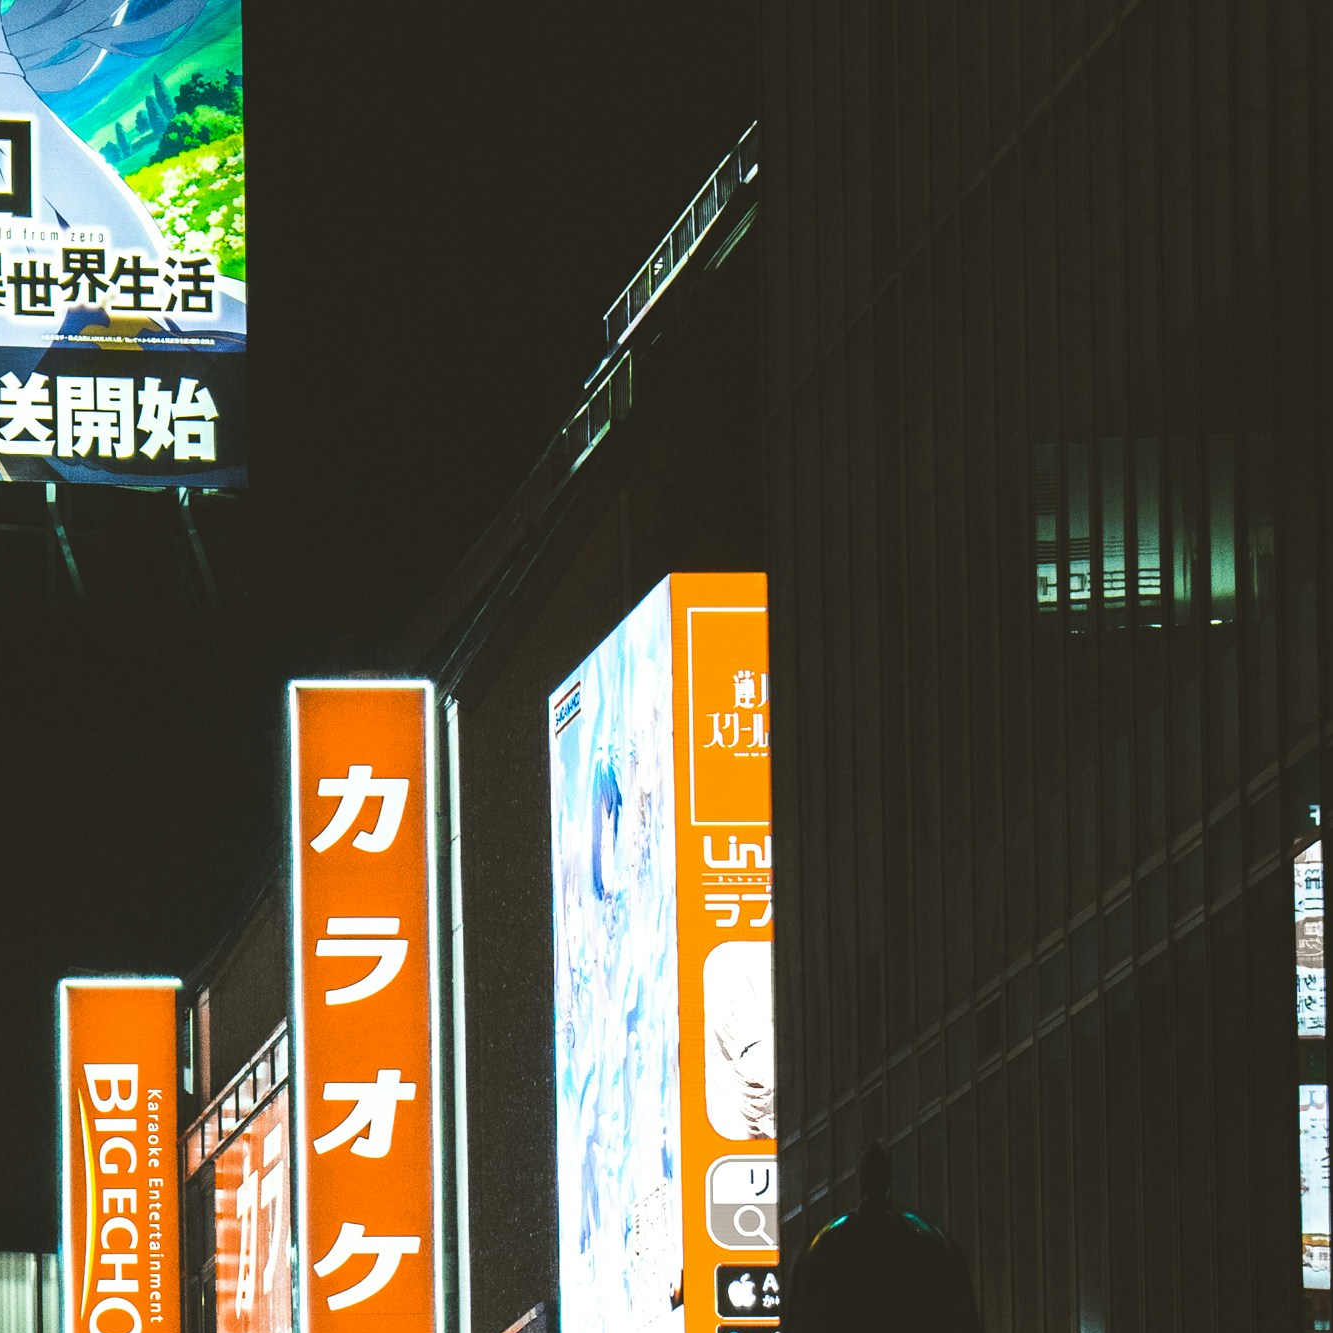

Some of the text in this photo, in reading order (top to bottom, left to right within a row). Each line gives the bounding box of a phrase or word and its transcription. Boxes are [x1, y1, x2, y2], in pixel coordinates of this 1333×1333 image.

[22, 224, 59, 241] from
[69, 231, 104, 243] zero
[84, 1062, 139, 1181] BIG
[311, 763, 420, 1312] カラオケ
[147, 1086, 165, 1325] Karaoke Entertainment
